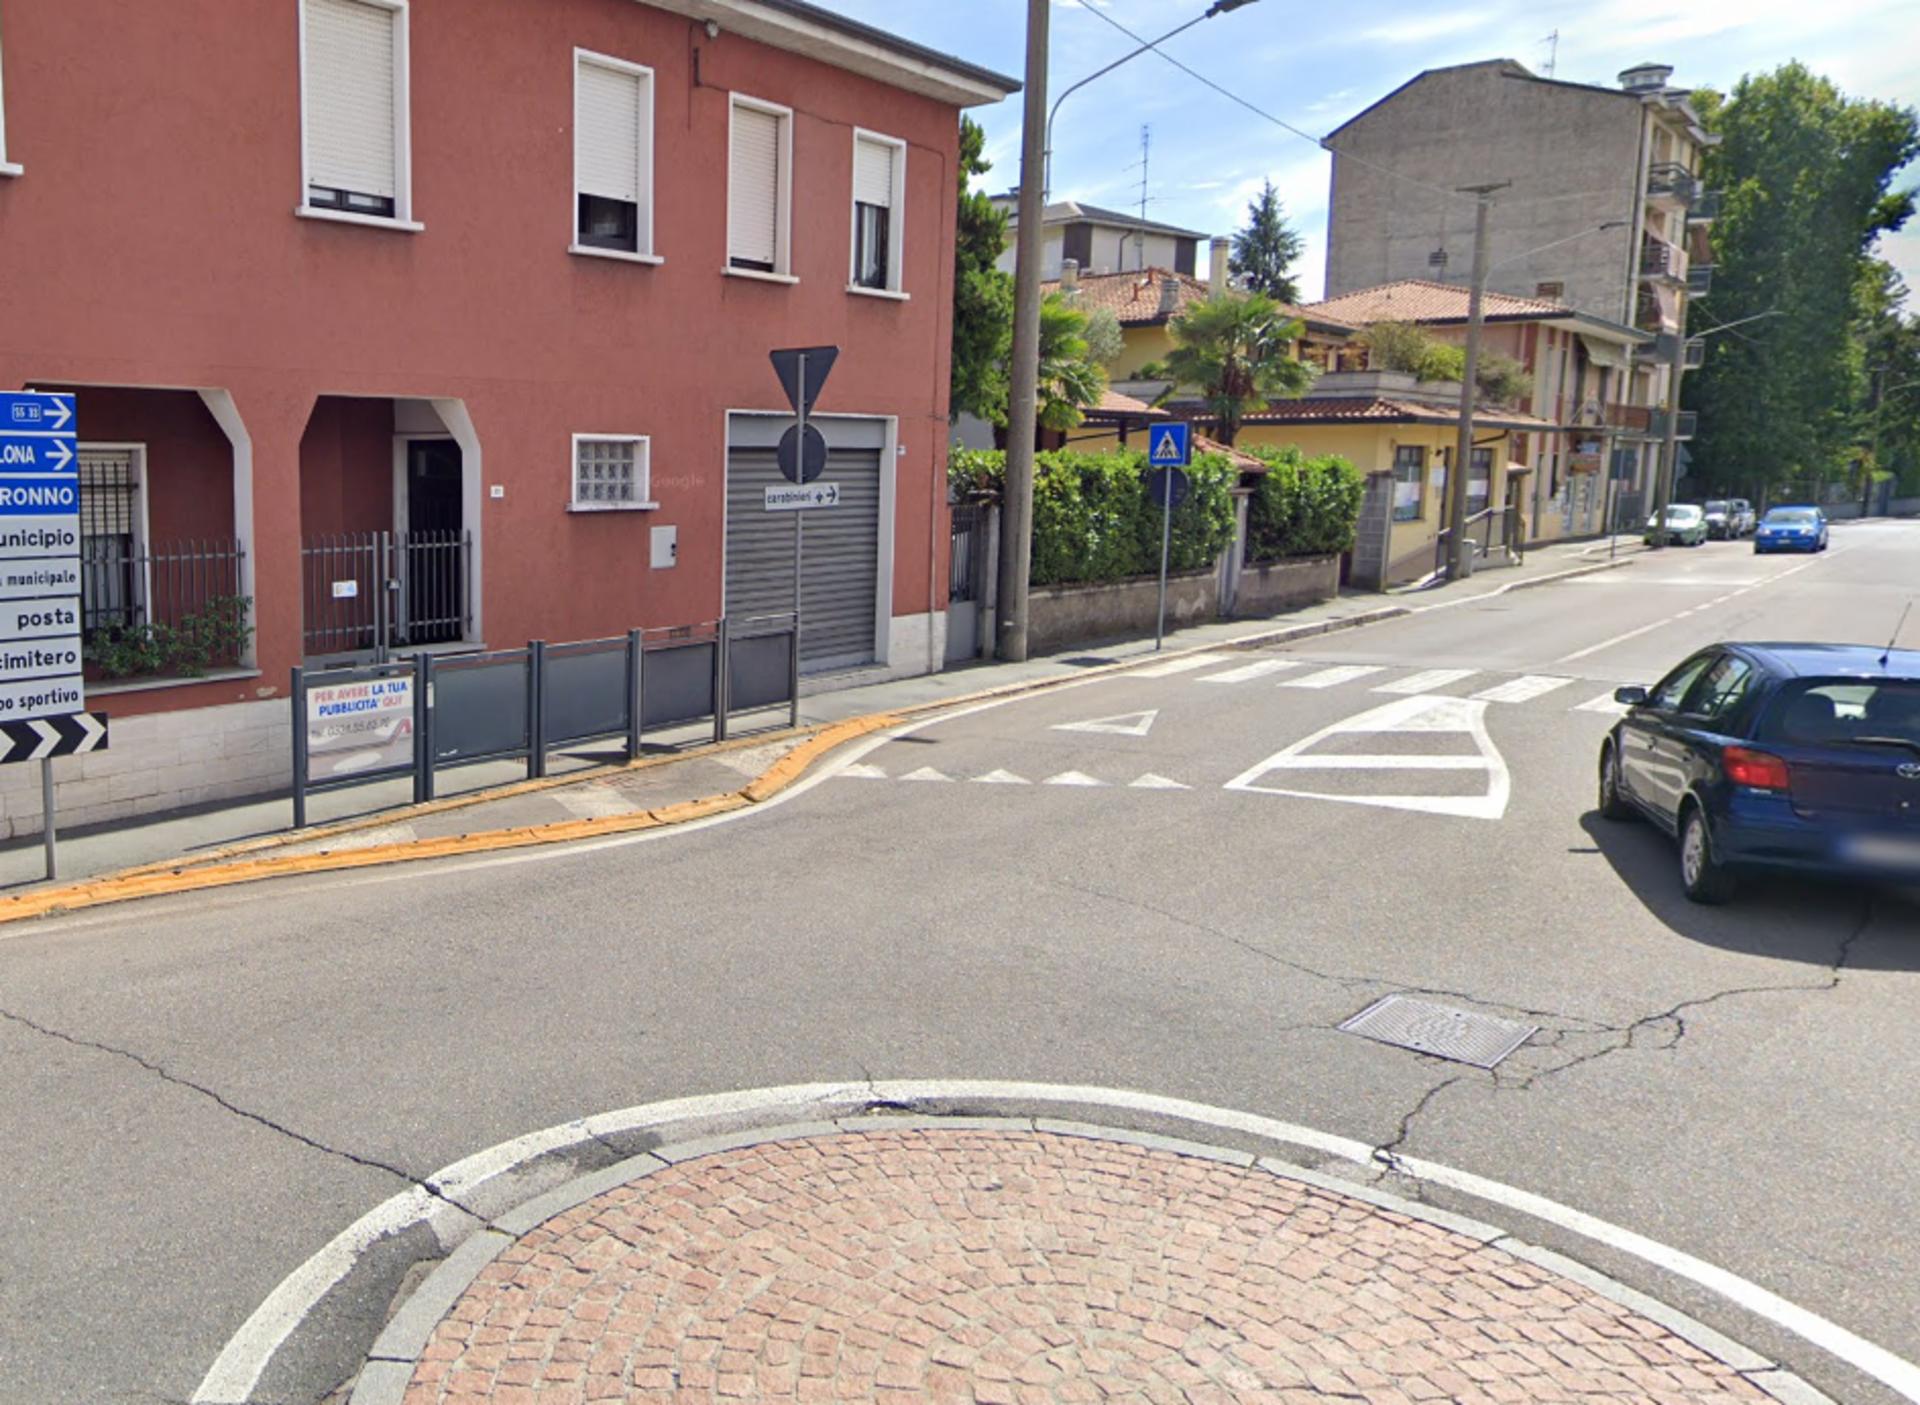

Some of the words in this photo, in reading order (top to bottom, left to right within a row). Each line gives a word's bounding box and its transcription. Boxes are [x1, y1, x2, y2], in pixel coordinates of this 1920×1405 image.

[0, 487, 74, 506] RONNO
[767, 490, 811, 504] carabinieri
[7, 570, 76, 587] municipale
[18, 608, 74, 630] posta
[19, 688, 78, 711] sportivo
[314, 690, 334, 703] PER
[337, 686, 369, 700] AVERE
[372, 684, 384, 695] LA
[388, 681, 407, 693] TUA
